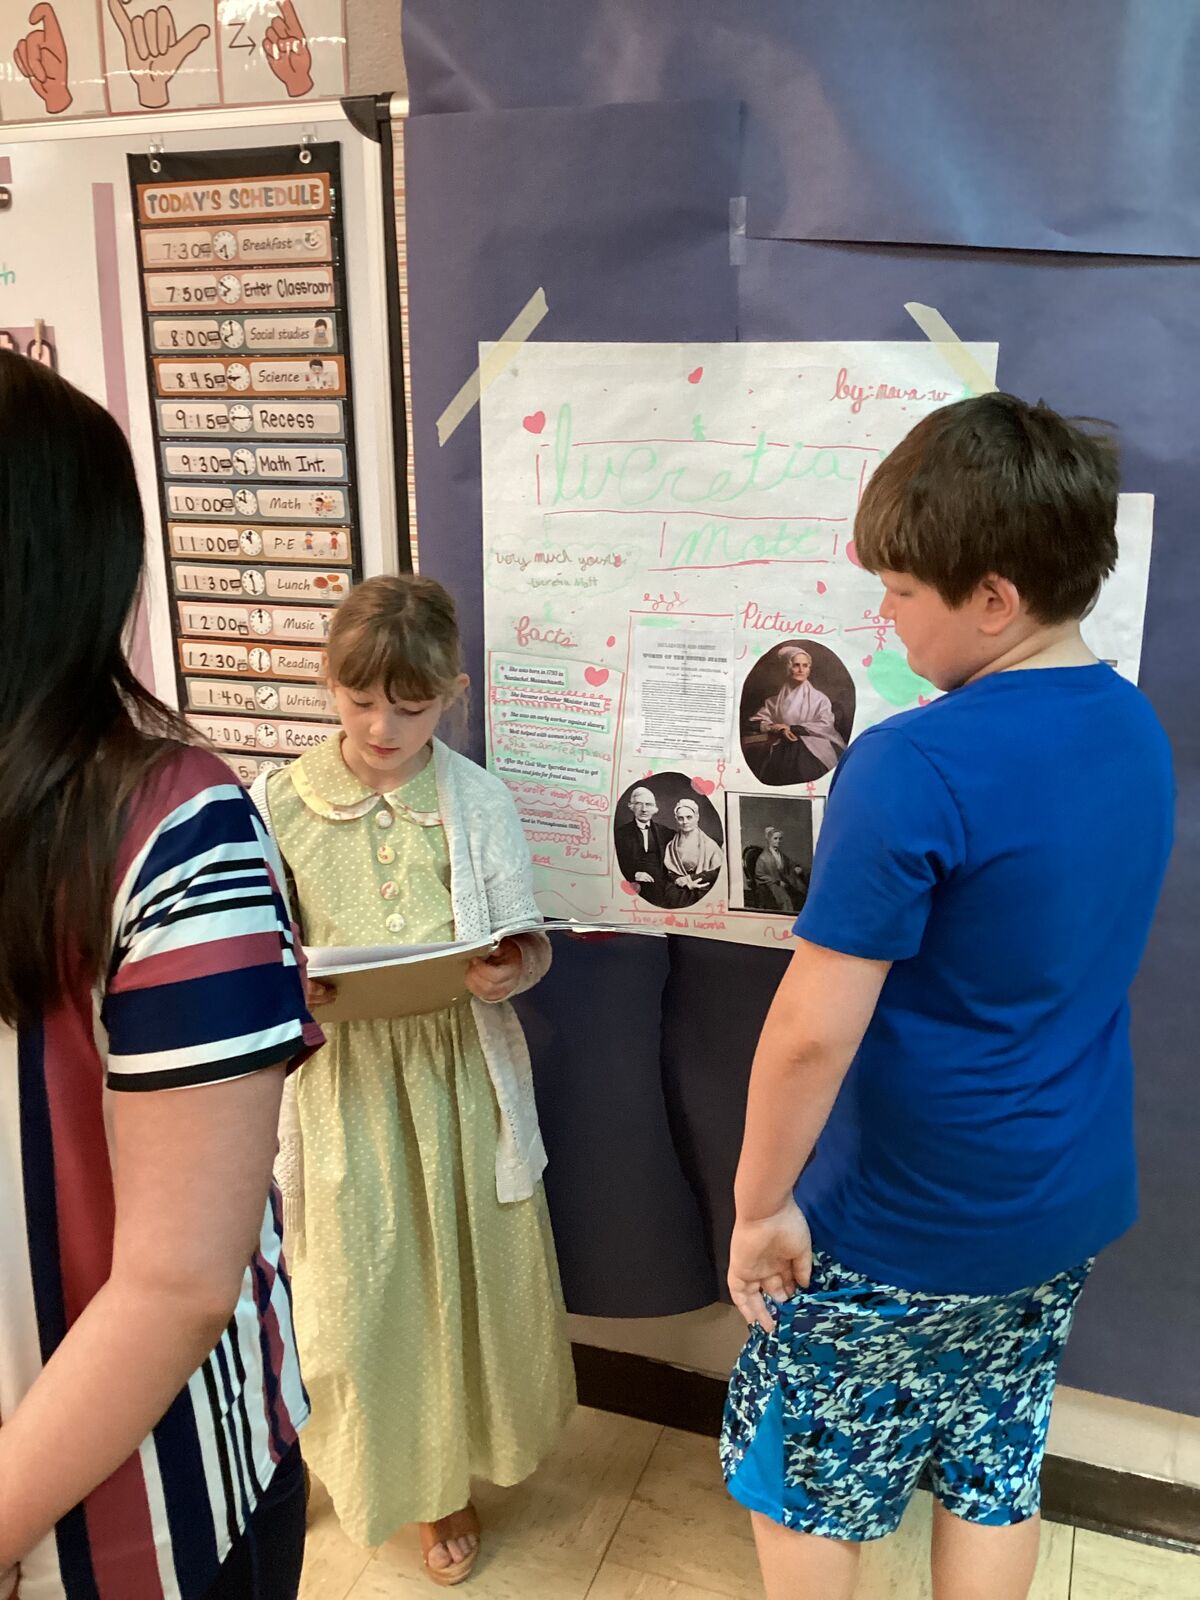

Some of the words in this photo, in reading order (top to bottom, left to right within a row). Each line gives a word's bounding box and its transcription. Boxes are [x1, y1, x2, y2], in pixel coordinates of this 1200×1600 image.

[147, 189, 221, 214] TODAY'S
[229, 184, 321, 209] SCHEDULE
[162, 242, 201, 260] 7:30
[242, 237, 293, 252] Breakfast
[166, 285, 204, 302] 7:50
[243, 281, 272, 298] Enter
[277, 278, 333, 298] Classroom
[170, 330, 207, 347] 8:00
[250, 327, 275, 340] Social
[278, 326, 310, 340] studies
[176, 372, 215, 389] 8:45
[258, 369, 301, 383] Science
[175, 410, 216, 430] 9:15
[259, 409, 315, 429] Recess
[182, 454, 220, 473] 9:30
[259, 455, 292, 474] Math
[295, 455, 326, 473] Int.
[174, 495, 222, 512] 10:00
[269, 497, 301, 511] Math
[179, 536, 226, 552] 11:00
[183, 574, 228, 591] 11:30
[277, 578, 311, 591] Lunch
[187, 614, 238, 632] 12:00
[283, 617, 316, 630] Music
[740, 600, 838, 635] Pictures
[188, 651, 236, 668] 12:30
[278, 656, 320, 672] Reading
[208, 688, 243, 705] 1:40
[286, 694, 328, 711] Writing
[207, 726, 241, 742] 2:00
